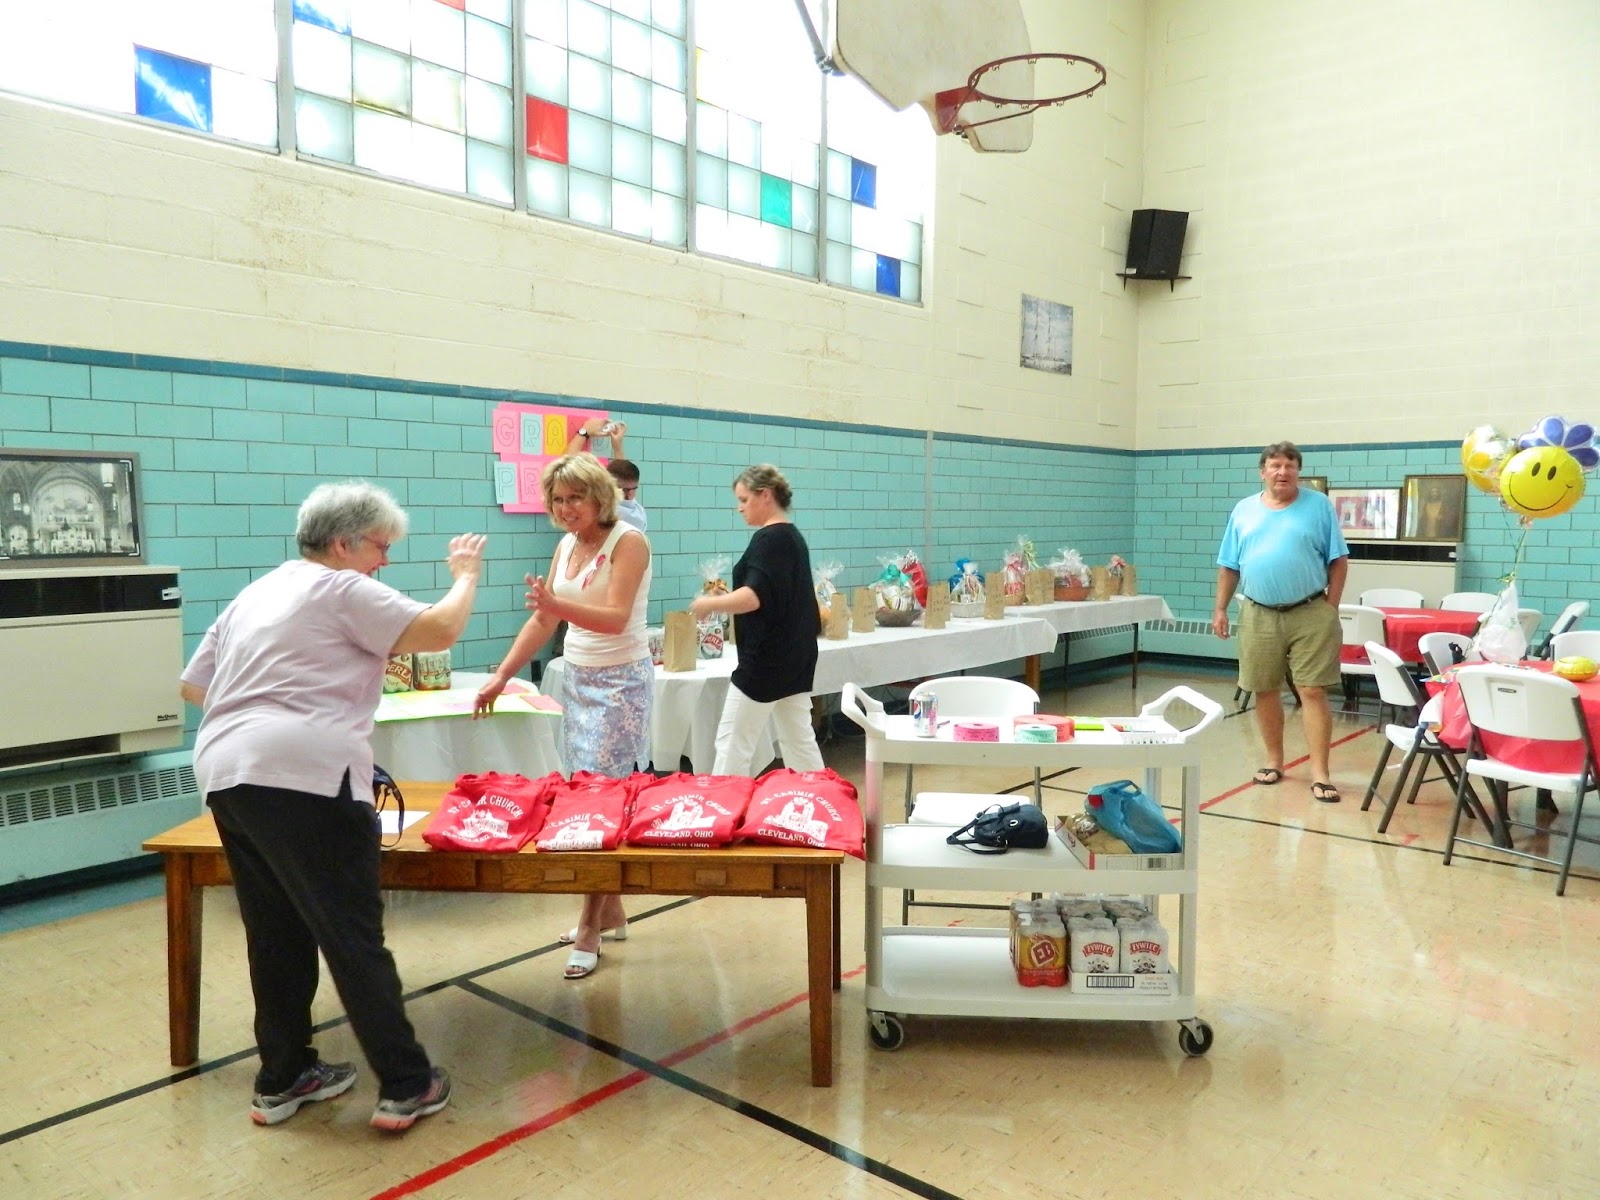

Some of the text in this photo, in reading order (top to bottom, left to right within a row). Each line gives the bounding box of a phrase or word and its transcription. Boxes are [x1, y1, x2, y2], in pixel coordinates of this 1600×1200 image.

[489, 795, 524, 818] CHURCH
[665, 794, 705, 806] CASIMIR
[815, 796, 843, 822] CHURCH
[644, 830, 714, 839] CLEVELAND, OHIO
[757, 828, 806, 844] CLEVELAND,
